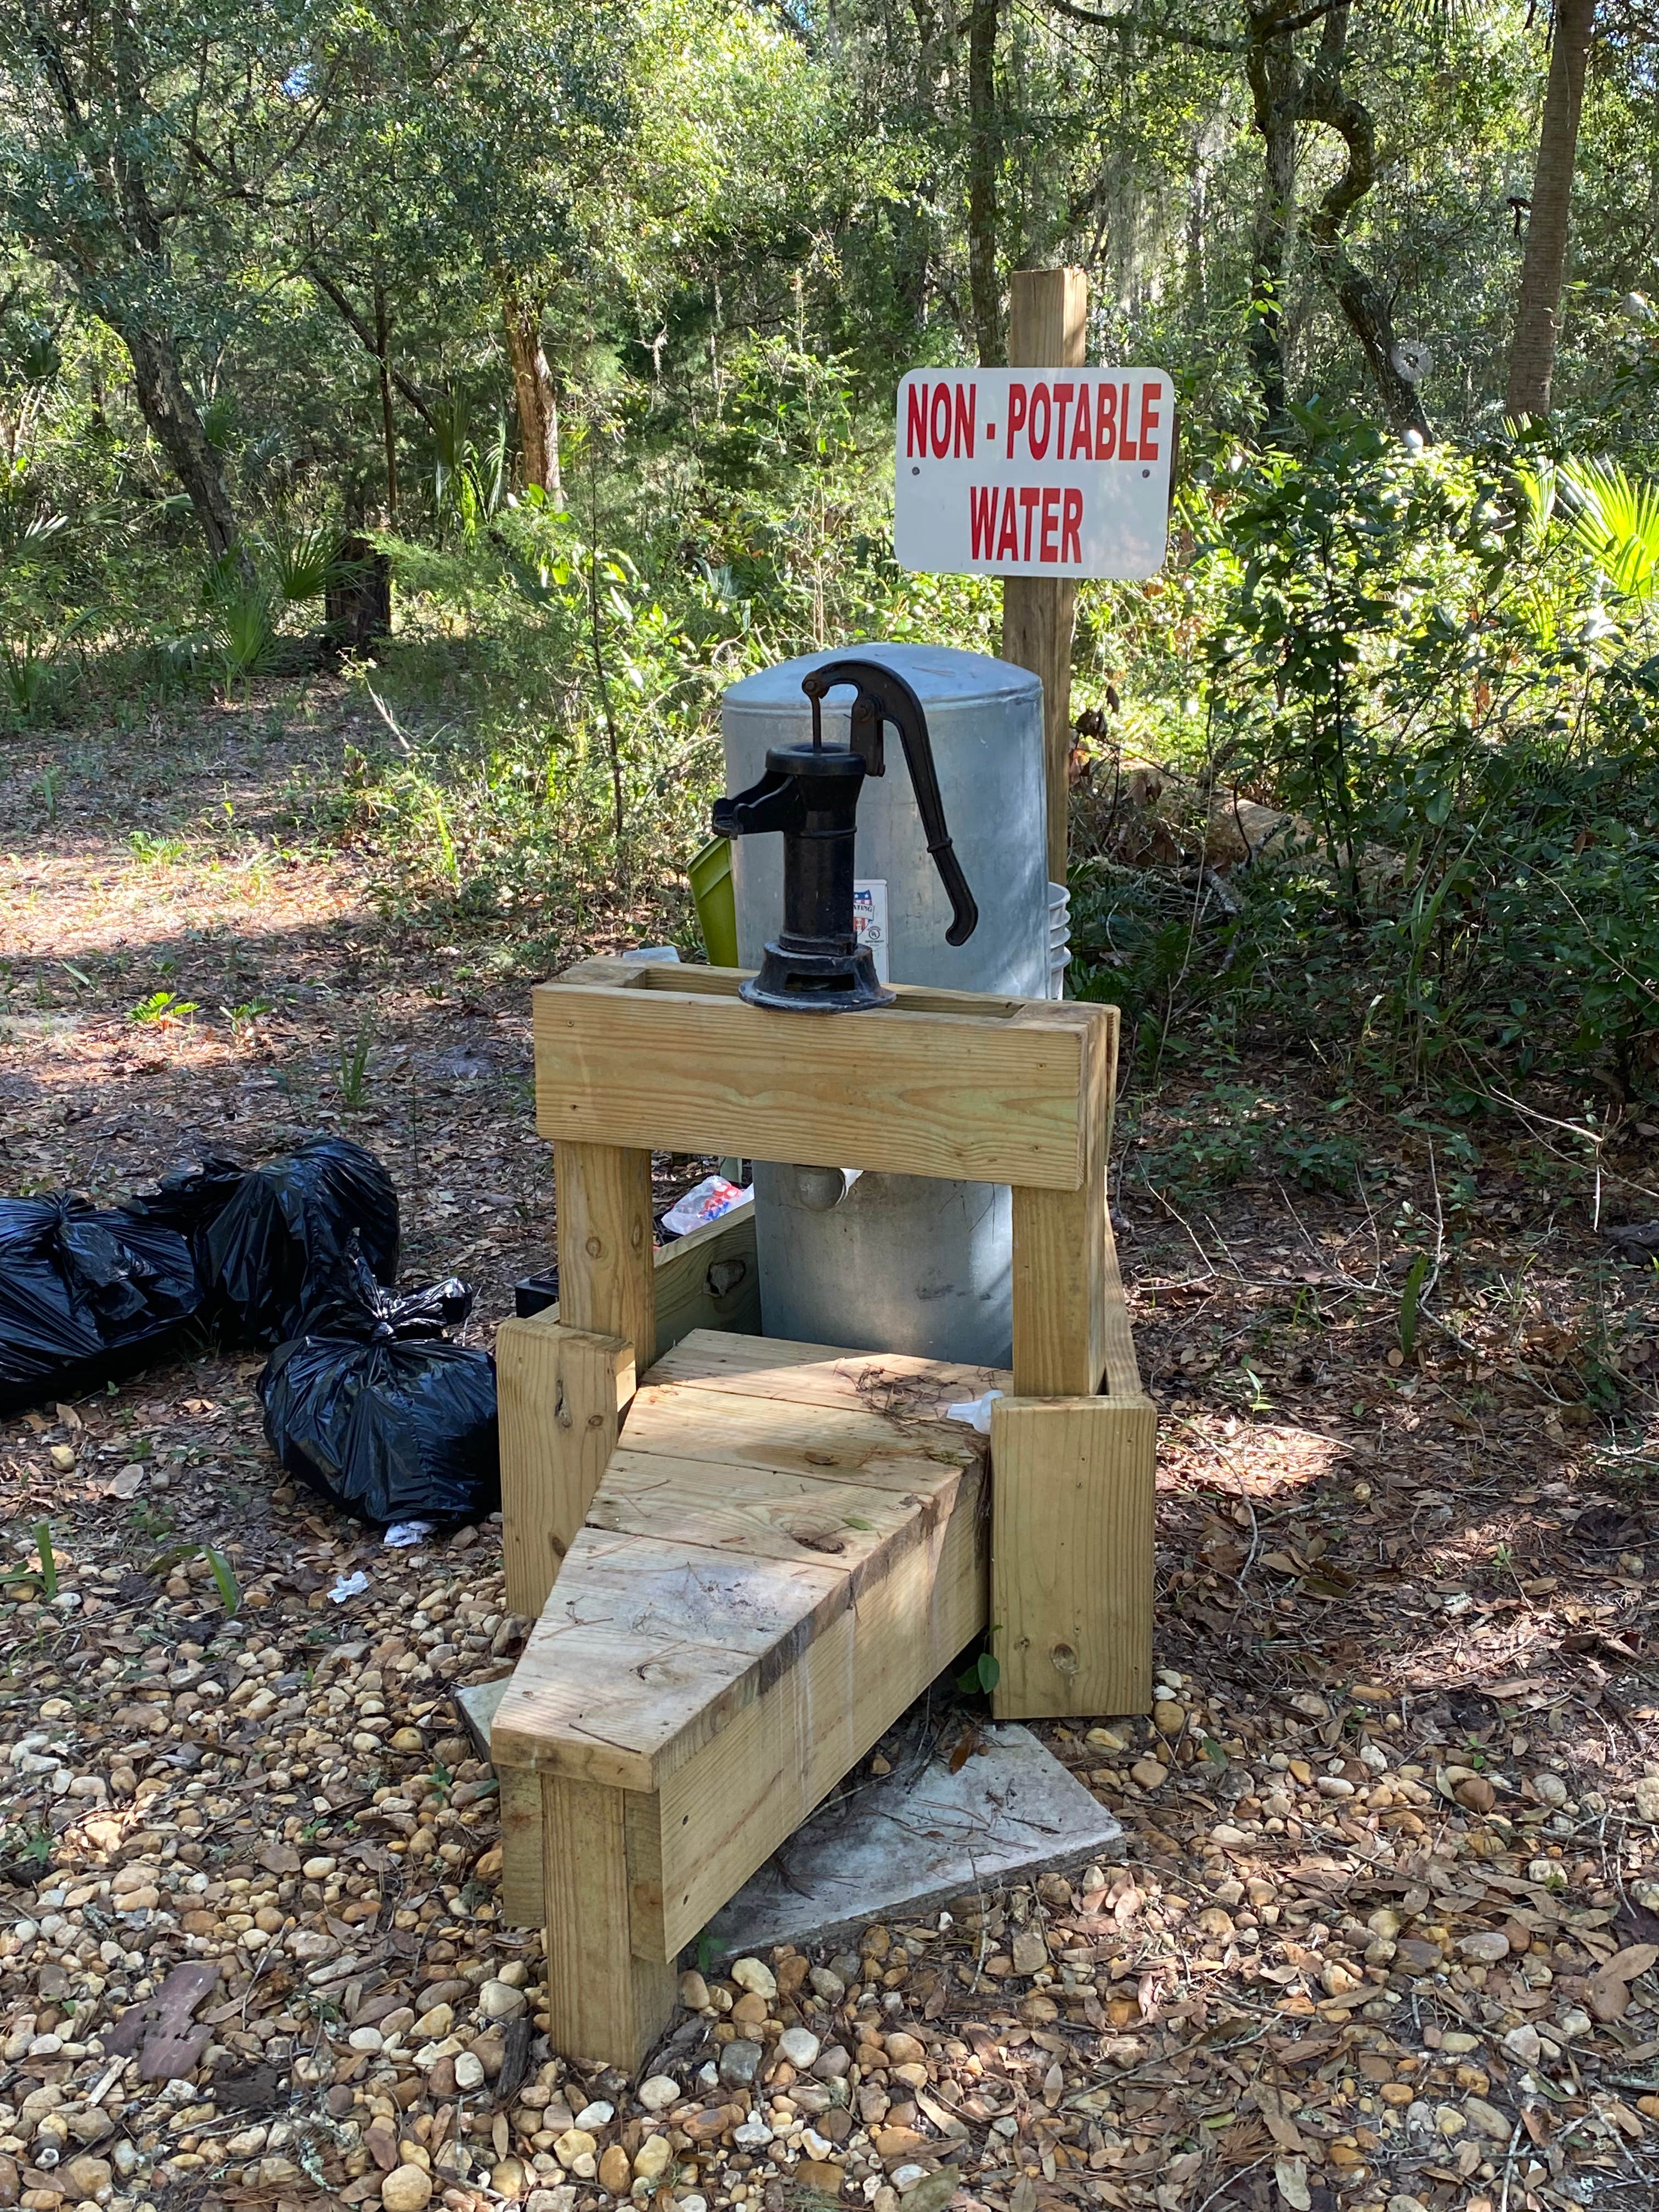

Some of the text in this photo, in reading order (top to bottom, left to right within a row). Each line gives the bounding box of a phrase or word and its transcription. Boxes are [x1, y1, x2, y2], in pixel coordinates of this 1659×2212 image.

[907, 382, 976, 459] NON
[1006, 382, 1161, 460] POTABLE
[970, 486, 1084, 563] WATER
